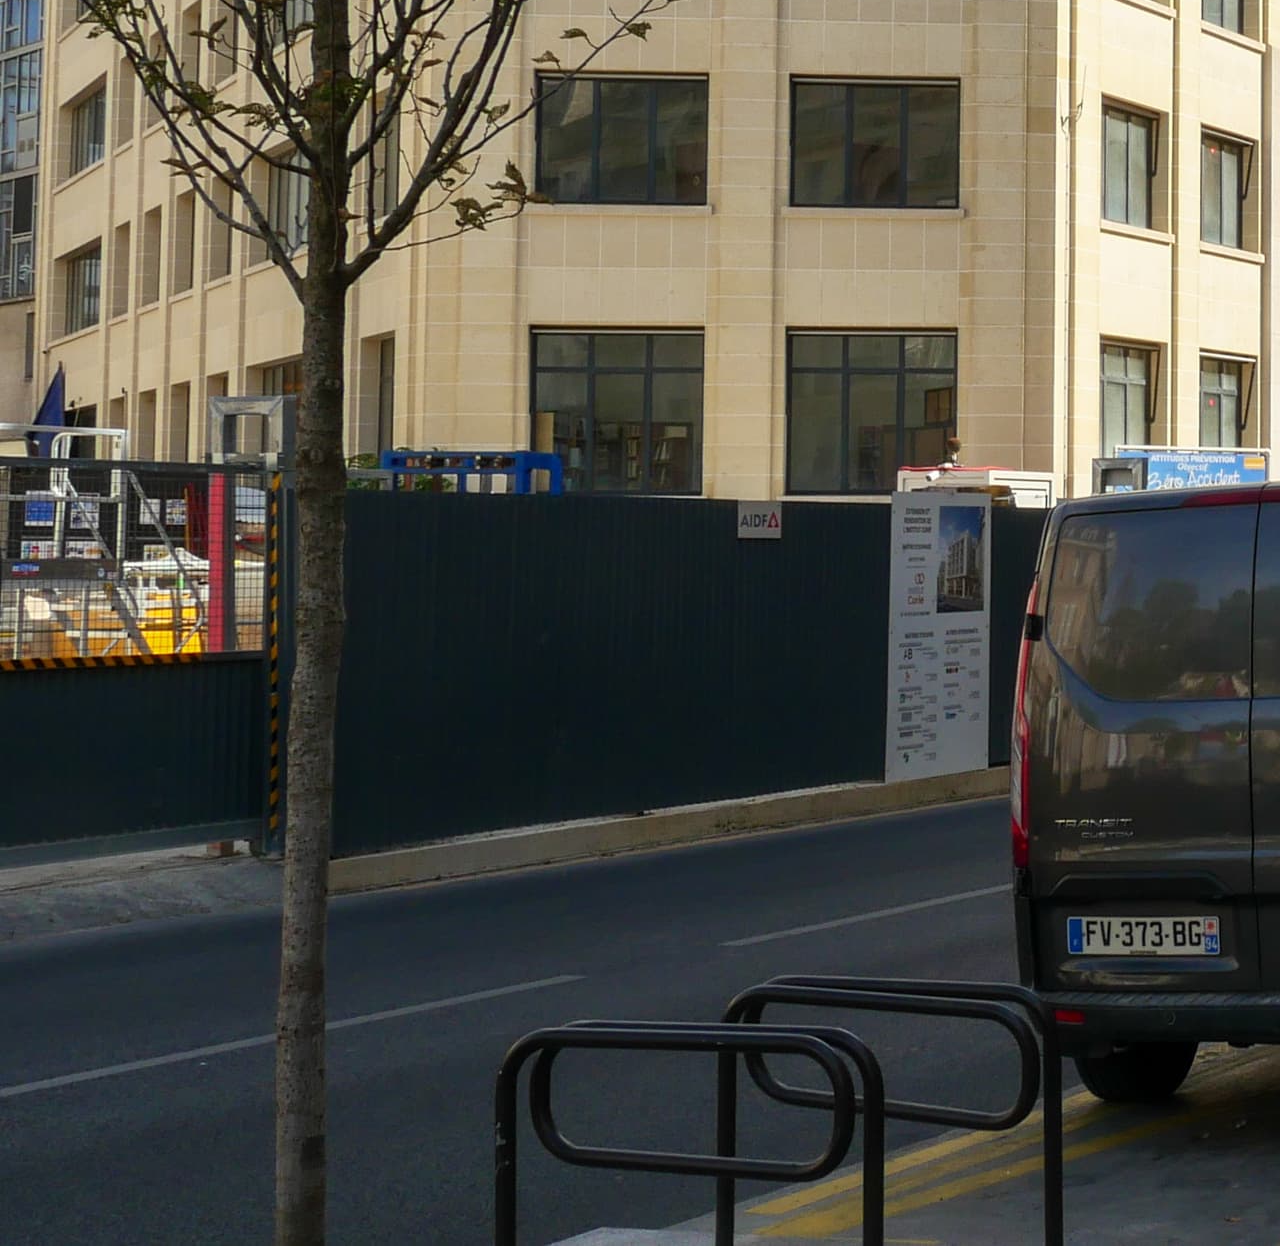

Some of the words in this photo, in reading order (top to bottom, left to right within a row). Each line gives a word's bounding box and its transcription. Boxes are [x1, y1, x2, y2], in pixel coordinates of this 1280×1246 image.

[1054, 818, 1133, 829] TRANSIT
[1081, 831, 1134, 839] CUSTOM
[1085, 920, 1202, 947] FV-373-BG
[1205, 936, 1218, 950] 94
